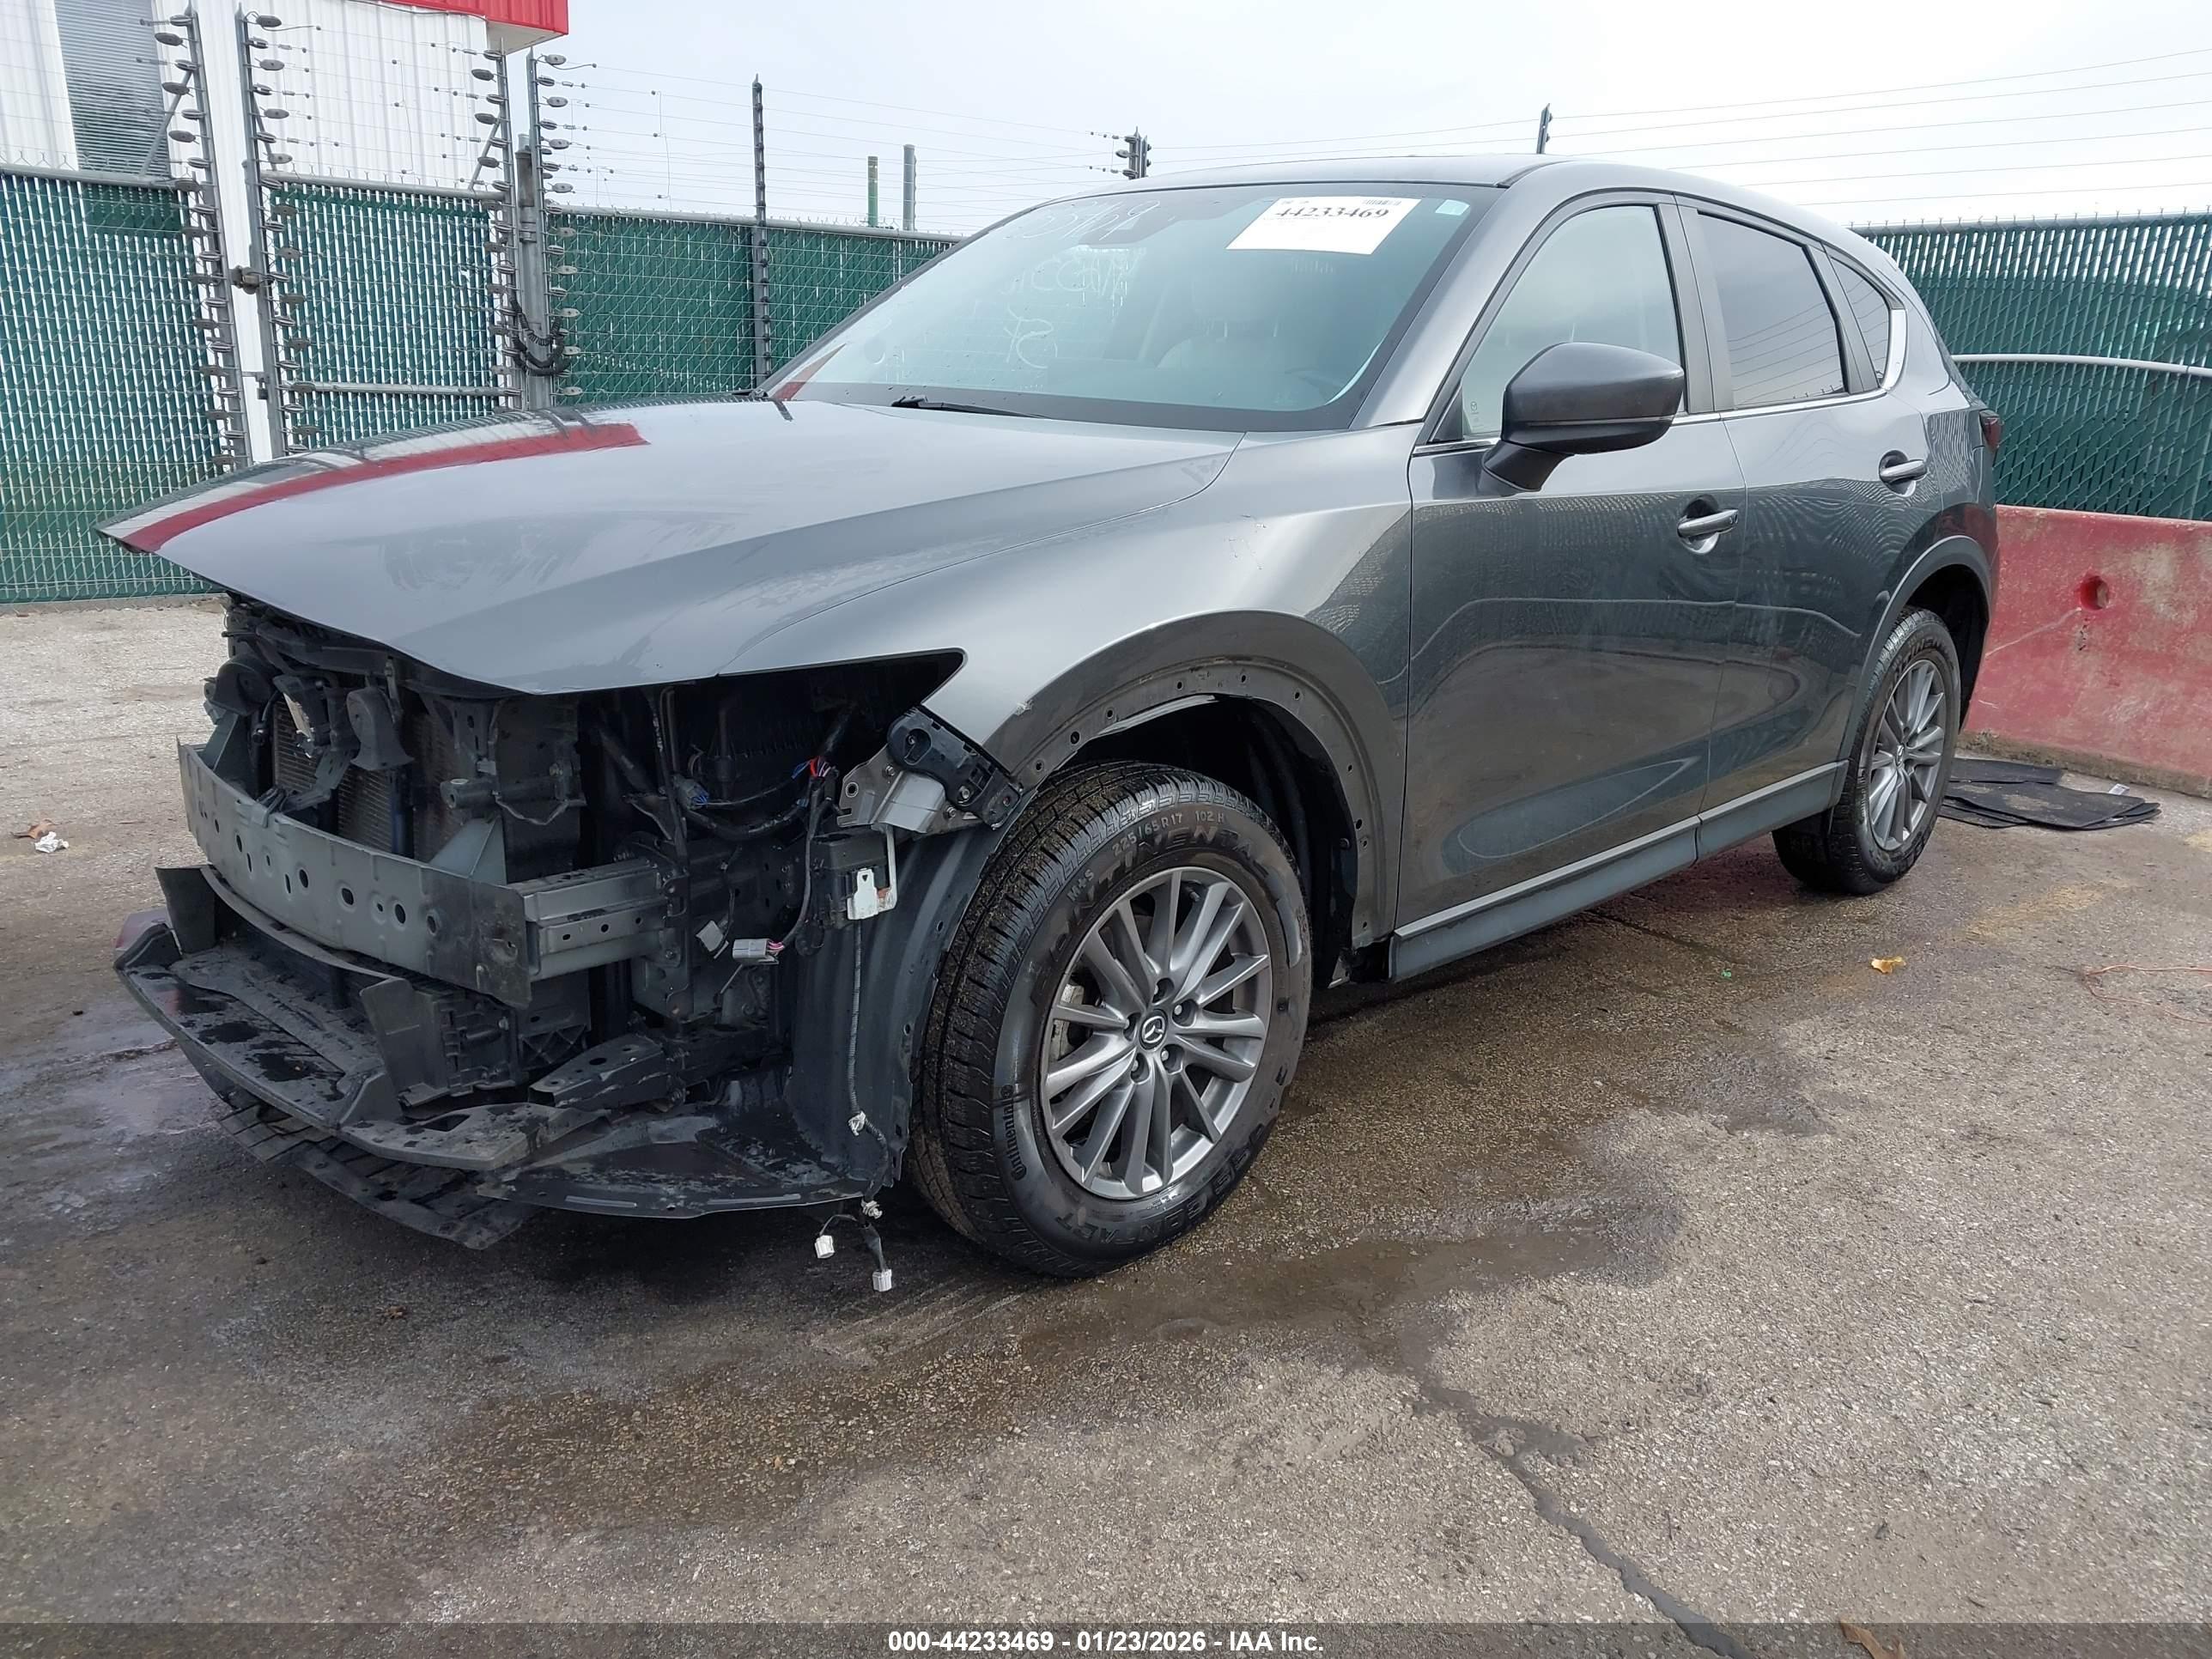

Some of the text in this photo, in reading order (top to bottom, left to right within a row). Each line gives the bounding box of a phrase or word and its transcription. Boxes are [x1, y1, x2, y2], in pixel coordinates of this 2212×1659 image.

[1276, 207, 1389, 218] 44233469
[1066, 868, 1095, 902] M+S
[1002, 1097, 1027, 1181] Continental
